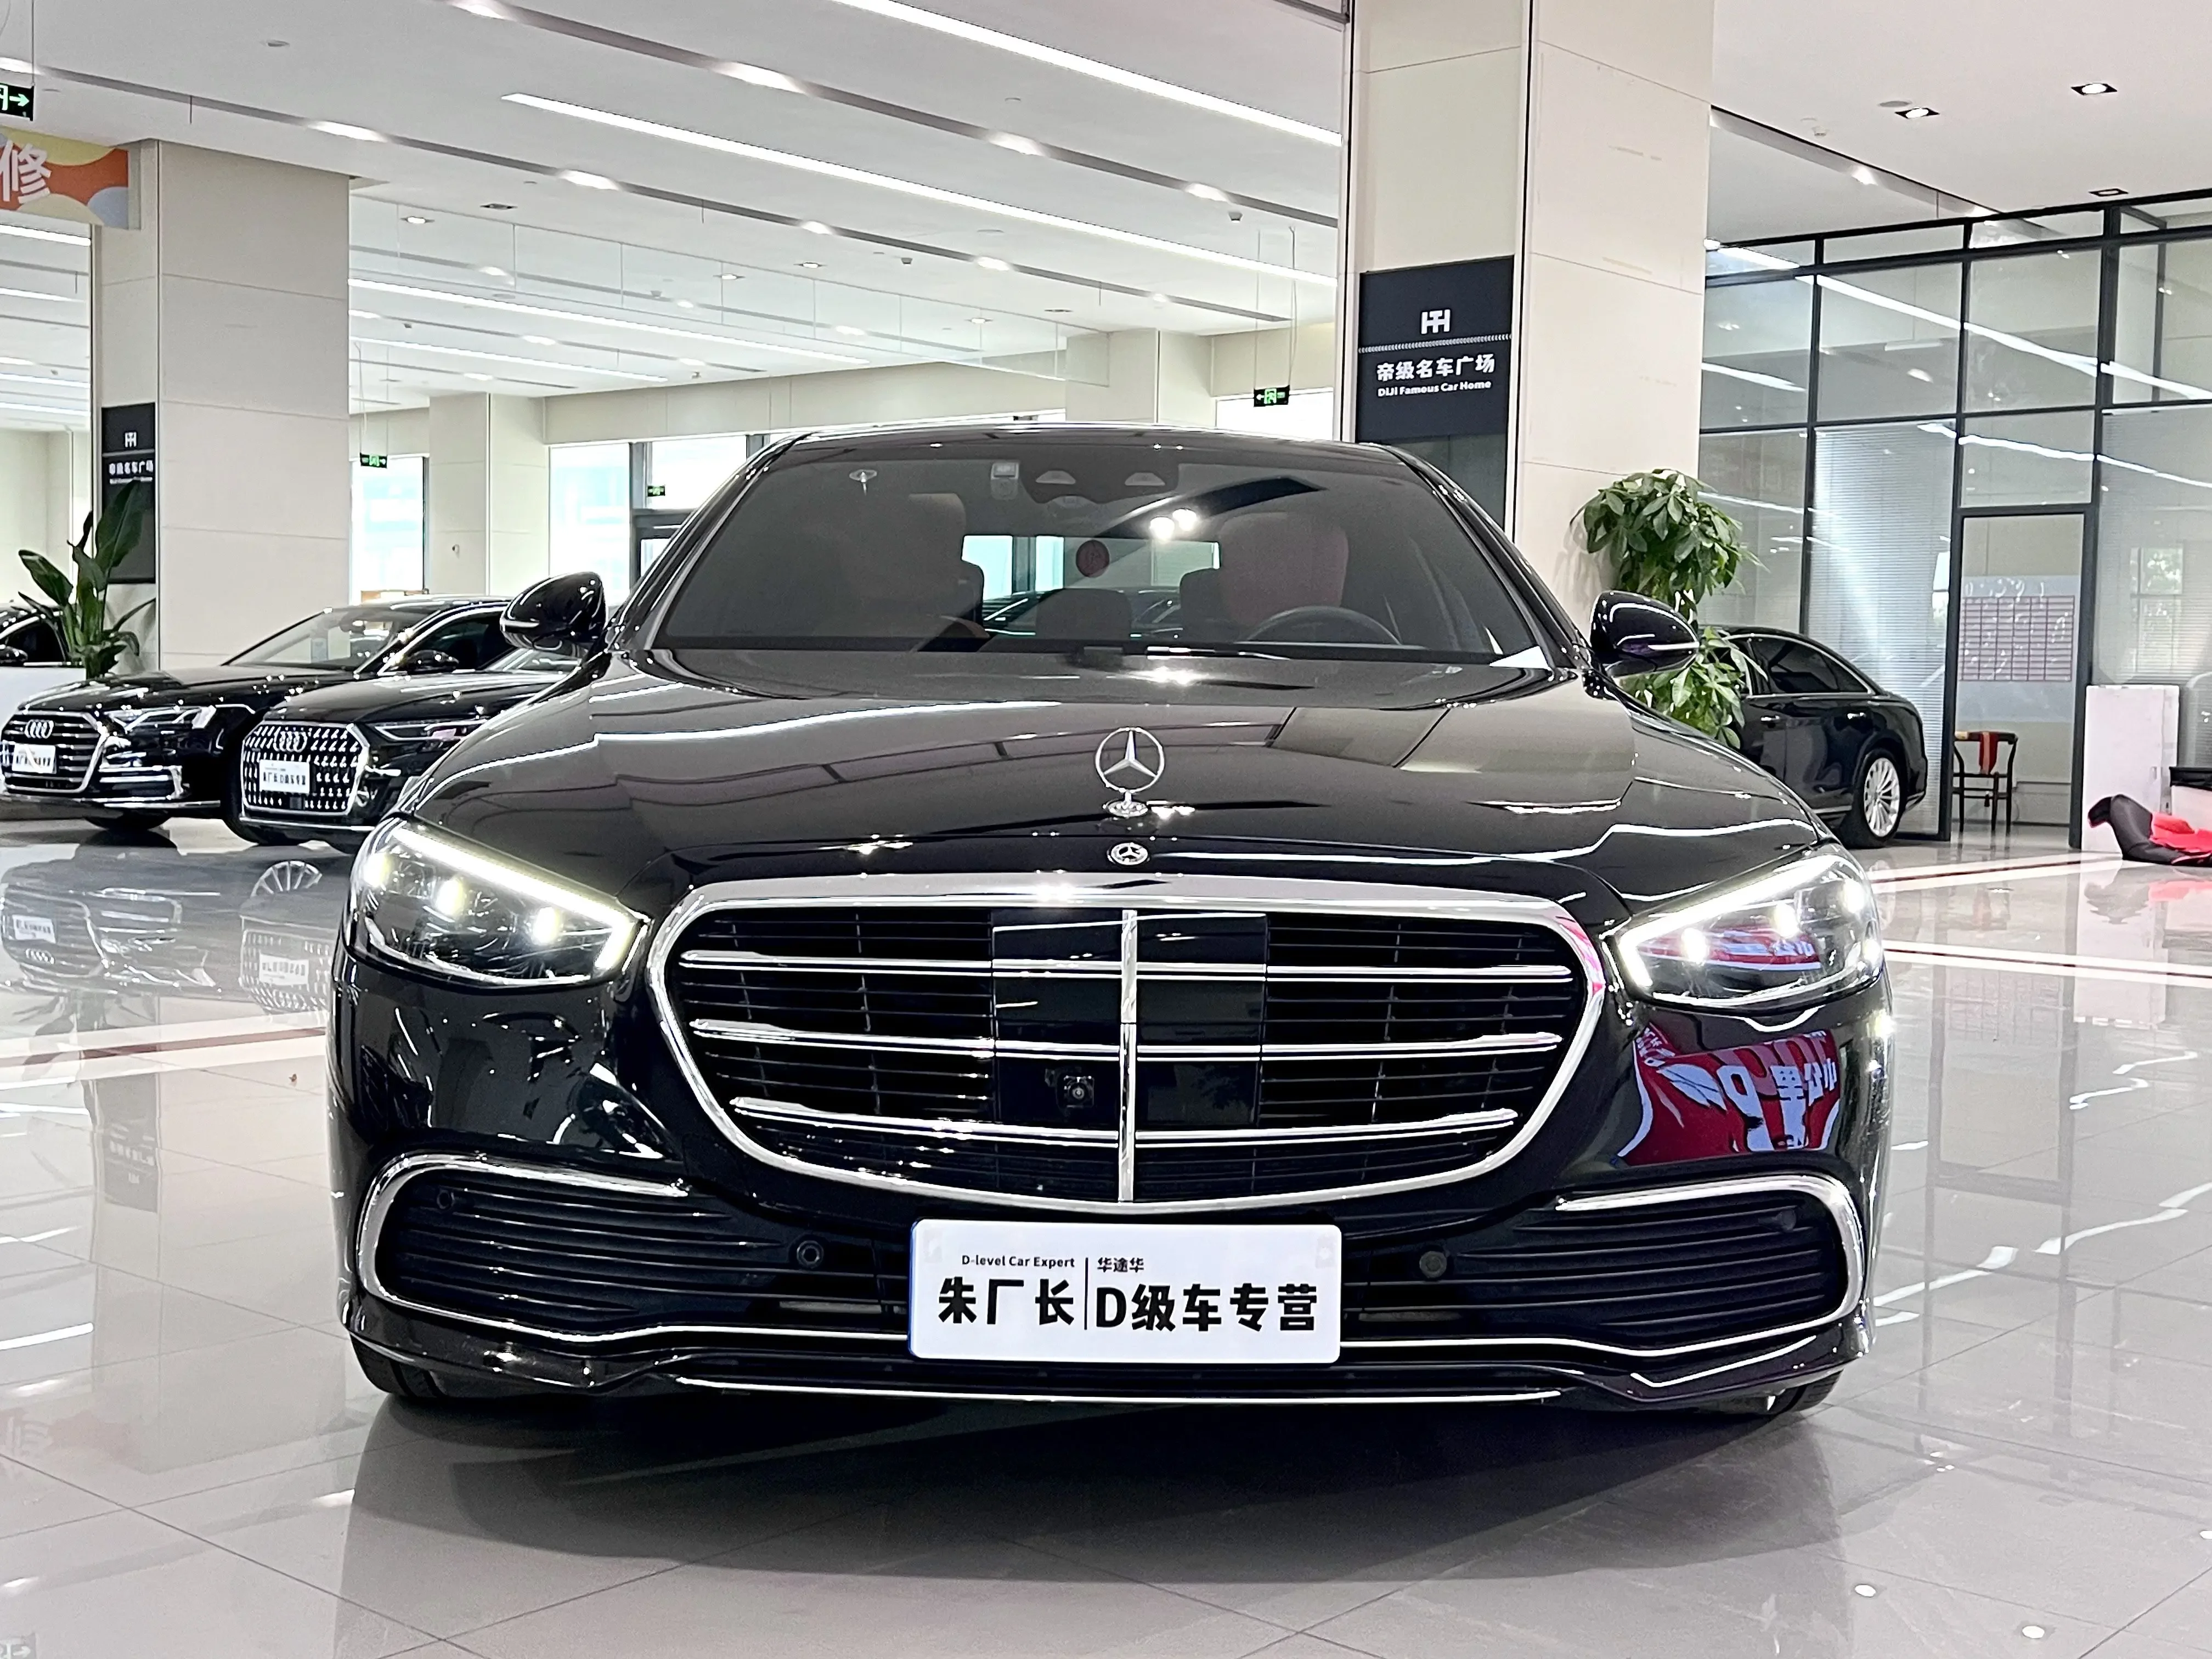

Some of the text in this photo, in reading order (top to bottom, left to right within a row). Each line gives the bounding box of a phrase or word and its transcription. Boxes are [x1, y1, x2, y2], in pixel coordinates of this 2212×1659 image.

[0, 140, 52, 205] 修
[1376, 353, 1495, 381] 帝级名车广场
[1400, 385, 1439, 395] Famous
[1441, 383, 1458, 391] Car
[1459, 381, 1492, 390] Home
[962, 1255, 1075, 1269] D-level Car Expert
[1097, 1257, 1144, 1273] 华途华
[938, 1276, 1317, 1332] 朱厂长 D级车专营
